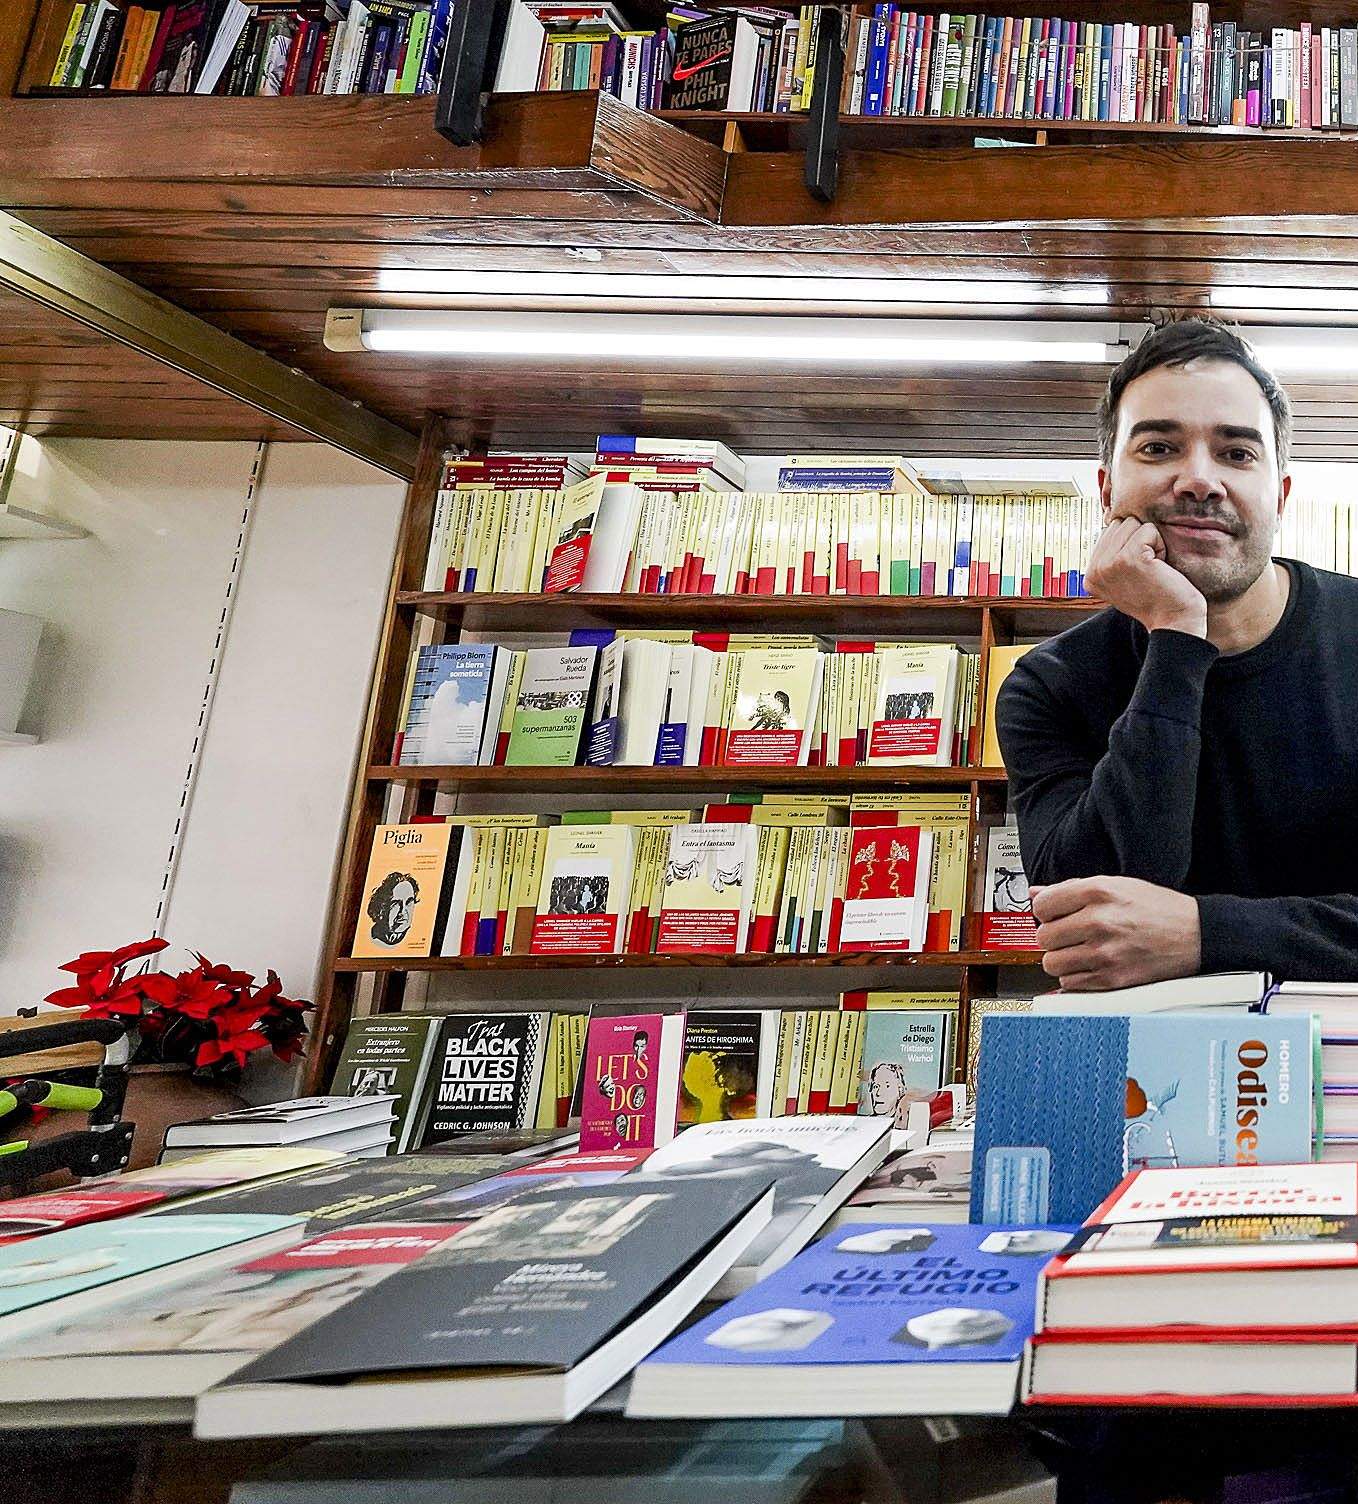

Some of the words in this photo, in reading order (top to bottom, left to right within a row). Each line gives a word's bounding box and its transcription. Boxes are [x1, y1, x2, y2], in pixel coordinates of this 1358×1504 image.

[1213, 28, 1222, 39] 13
[683, 26, 729, 52] NUNCA
[676, 50, 690, 66] TE
[693, 40, 732, 62] PARES
[684, 69, 717, 89] PHIL
[671, 86, 729, 109] KNIGHT
[443, 652, 466, 662] Philipp
[467, 652, 486, 660] Blom
[560, 656, 588, 666] Salvador
[455, 661, 465, 669] La
[466, 661, 485, 669] tierra
[782, 664, 797, 672] tigre
[449, 670, 483, 678] sometida
[563, 715, 577, 724] 503
[521, 723, 576, 733] supermanzanas
[383, 830, 423, 848] Piglia
[681, 840, 700, 848] Entra
[700, 840, 709, 848] el
[709, 839, 736, 849] fantasma
[997, 843, 1018, 851] Cómo
[467, 1020, 505, 1042] Tras
[909, 1024, 935, 1033] Estrella
[366, 1038, 400, 1048] Extranjero
[686, 1036, 707, 1044] ANTES
[707, 1036, 716, 1044] DE
[716, 1036, 754, 1044] HIROSHIMA
[842, 1030, 850, 1051] cuchillos
[902, 1034, 913, 1043] de
[913, 1034, 935, 1044] Diego
[356, 1047, 365, 1055] en
[366, 1047, 381, 1055] todas
[383, 1047, 406, 1056] partes
[446, 1038, 519, 1056] BLACK
[900, 1044, 934, 1053] Tristísimo
[907, 1054, 934, 1064] Warhol
[444, 1059, 516, 1079] LIVES
[596, 1053, 649, 1081] LET'S
[1278, 1040, 1291, 1105] HOMERO
[438, 1083, 514, 1102] MATTER
[433, 1121, 461, 1130] CEDRIC
[462, 1121, 471, 1130] G.
[472, 1121, 511, 1131] JOHNSON
[913, 1256, 960, 1268] EL
[521, 1263, 584, 1274] Mireya
[833, 1266, 1011, 1281] ÚLTIMO
[800, 1283, 1021, 1297] REFUGIO
